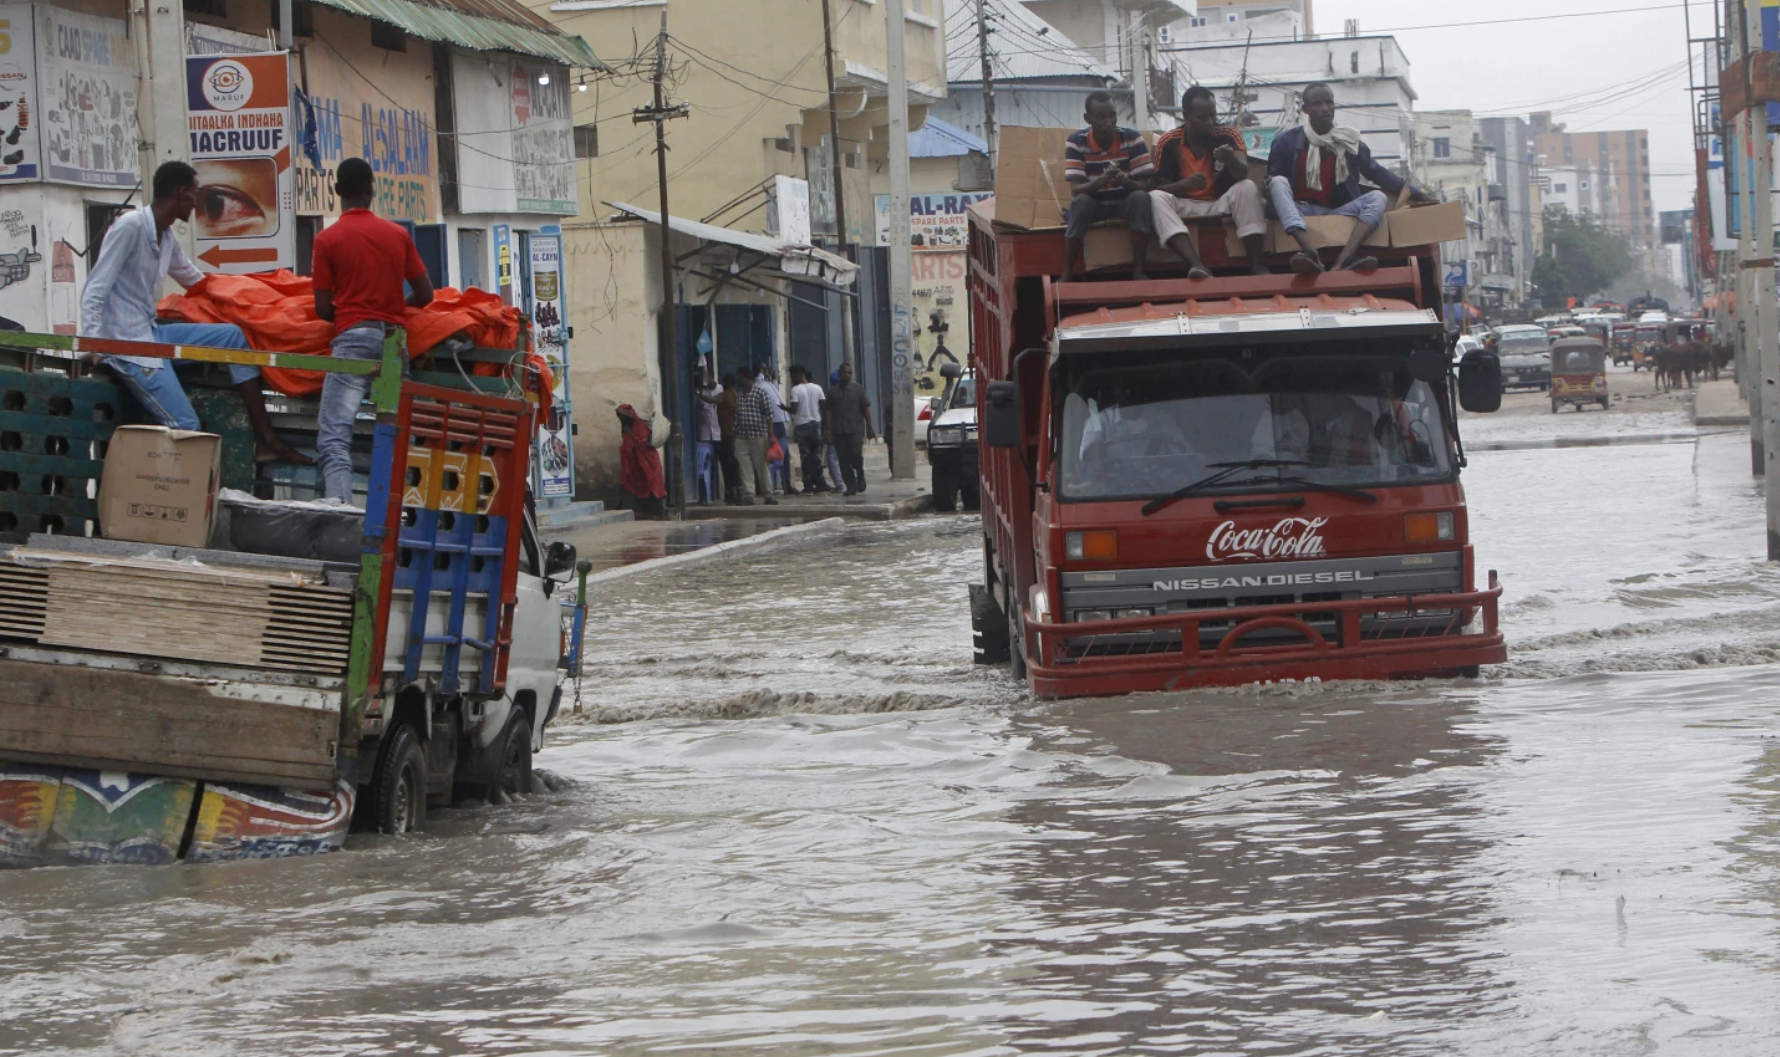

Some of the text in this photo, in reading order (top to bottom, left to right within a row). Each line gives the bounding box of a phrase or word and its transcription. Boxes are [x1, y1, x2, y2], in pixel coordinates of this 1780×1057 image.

[238, 113, 284, 128] INDHAHA
[911, 216, 965, 226] SPARE PARTS
[1153, 570, 1374, 592] NISSAN DIESEL
